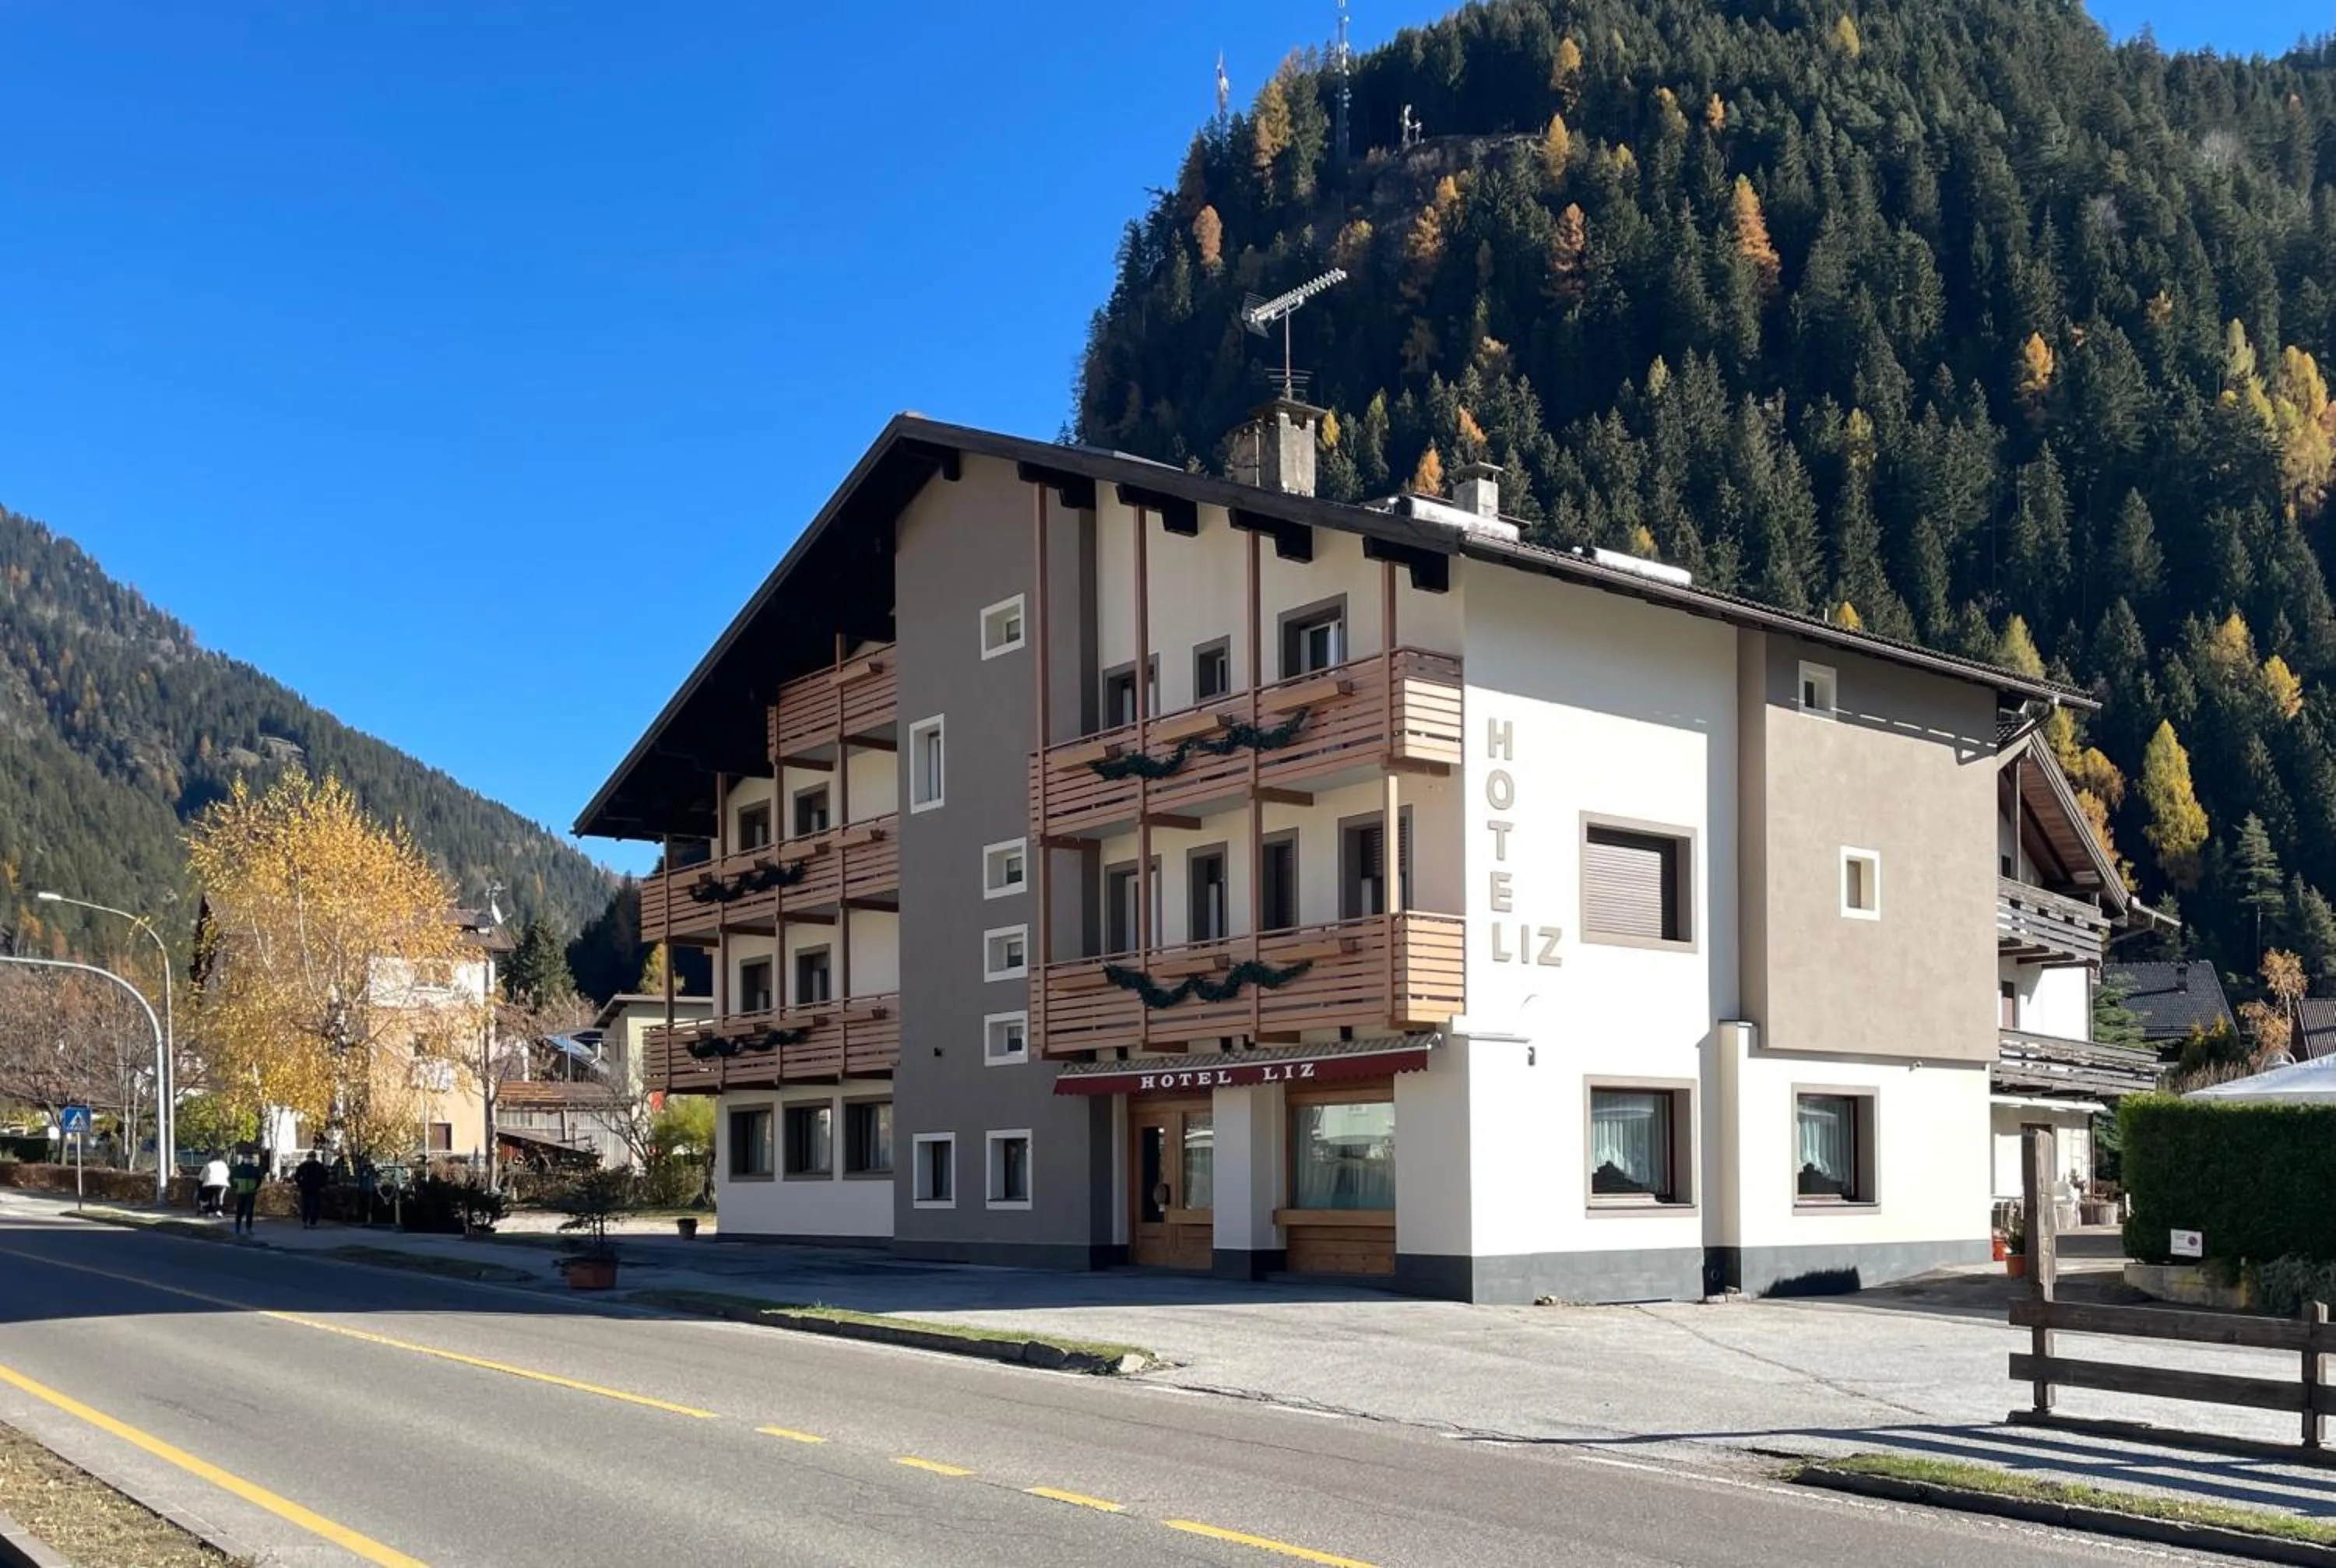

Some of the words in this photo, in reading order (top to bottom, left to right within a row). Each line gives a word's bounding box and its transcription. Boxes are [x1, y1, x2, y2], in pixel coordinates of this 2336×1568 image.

[1486, 718, 1515, 963] HOTEL
[1492, 922, 1563, 967] LIZ
[1141, 1071, 1232, 1089] HOTEL
[1263, 1063, 1315, 1081] LIZ
